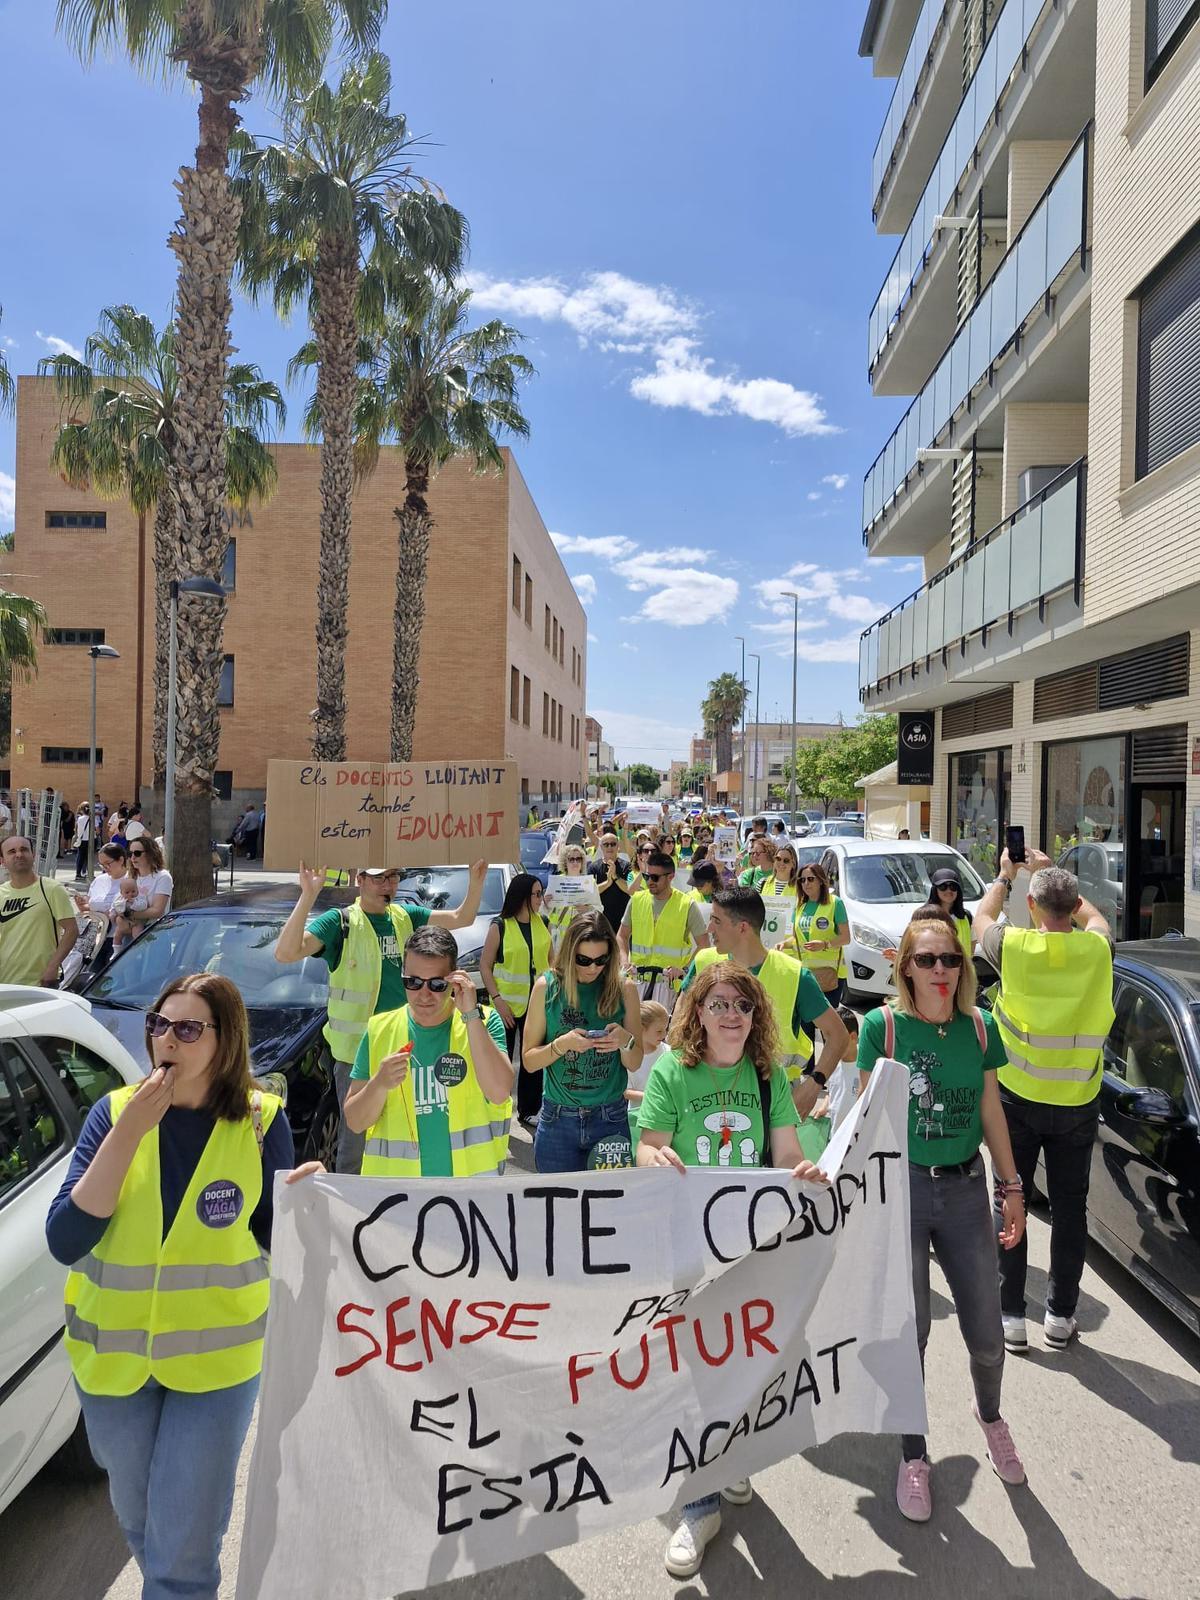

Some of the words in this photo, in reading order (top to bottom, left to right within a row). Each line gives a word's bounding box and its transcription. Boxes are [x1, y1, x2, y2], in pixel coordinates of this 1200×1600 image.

[907, 734, 926, 743] ASIA
[300, 767, 327, 785] Els
[336, 769, 414, 786] DOCENTS
[357, 793, 416, 813] també
[321, 819, 371, 838] estem
[396, 811, 504, 841] EDUCANT
[3, 897, 30, 912] NIKE
[441, 1057, 463, 1065] DOCENT
[442, 1067, 461, 1076] VAGA
[598, 1142, 630, 1153] DOCENT
[606, 1154, 621, 1164] EN
[205, 1188, 236, 1200] DOCENT
[205, 1201, 235, 1215] VAGA
[353, 1187, 631, 1282] CONTE
[335, 1297, 550, 1376] SENSE
[568, 1298, 780, 1405] FUTUR
[410, 1387, 500, 1450] EL
[437, 1431, 613, 1535] ESTÀ
[659, 1337, 857, 1488] ACABAT
